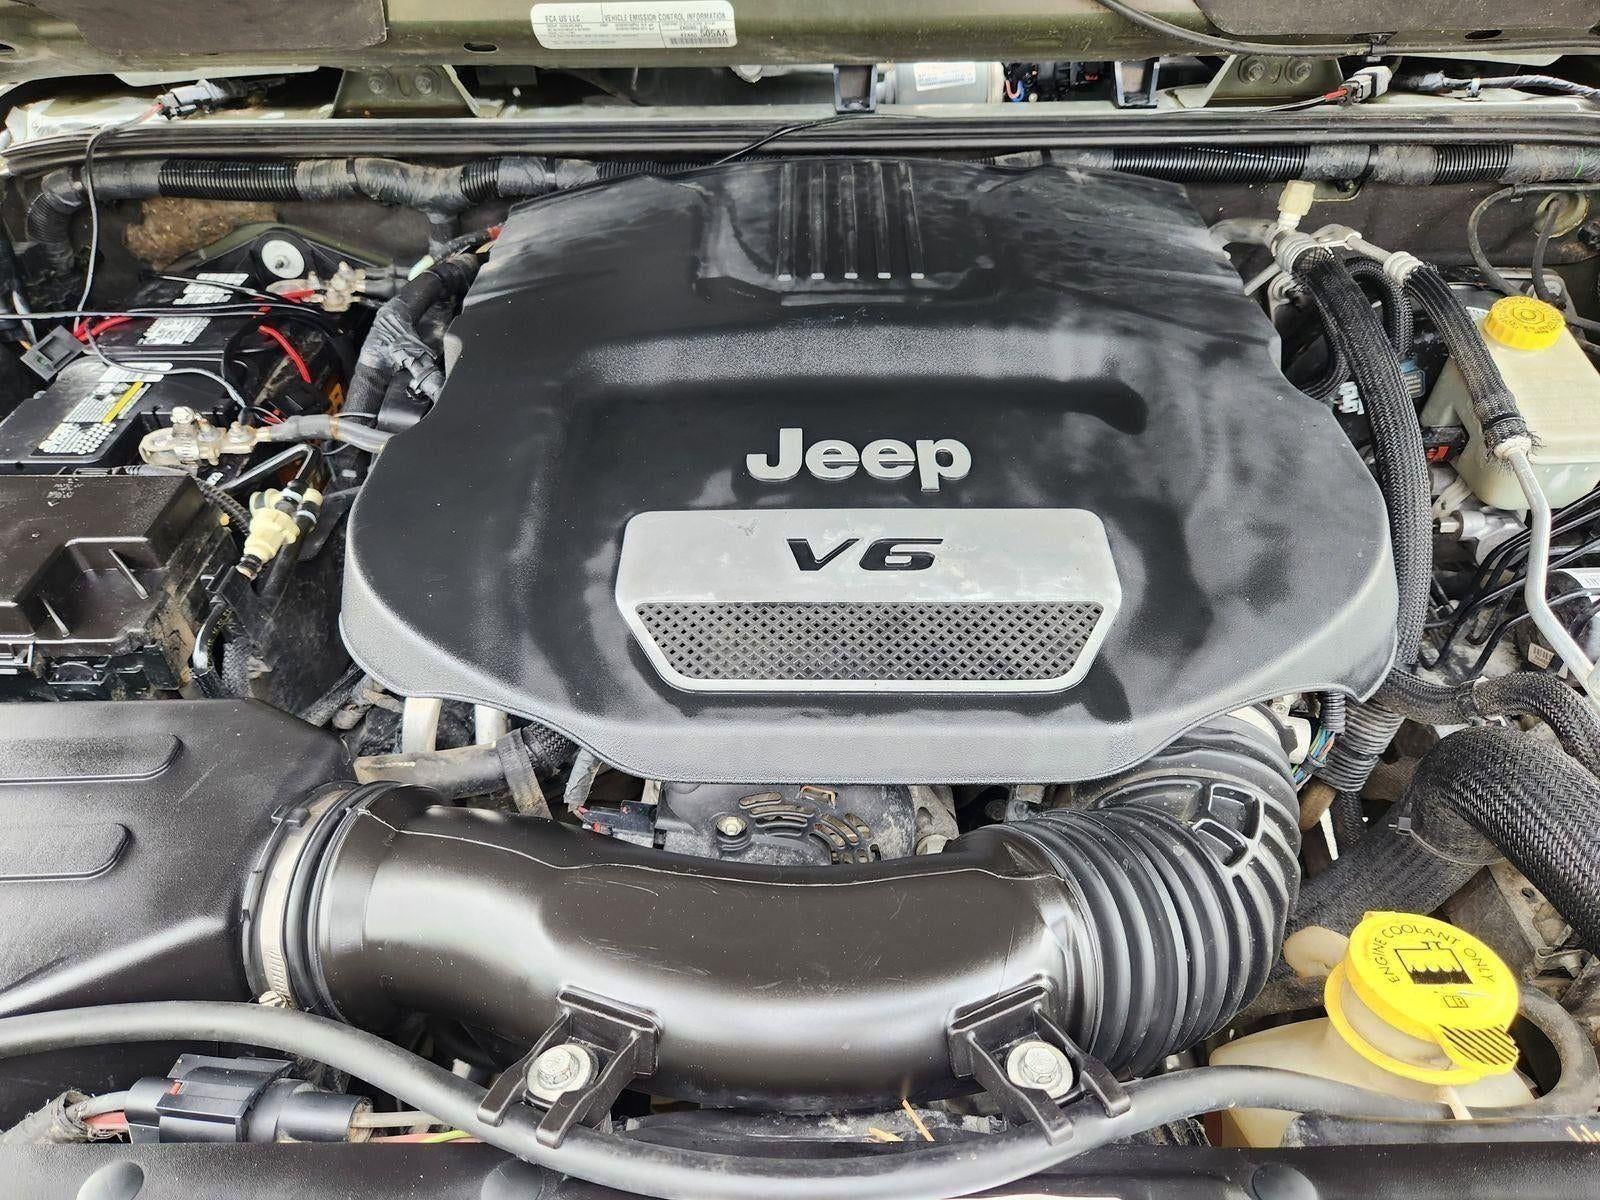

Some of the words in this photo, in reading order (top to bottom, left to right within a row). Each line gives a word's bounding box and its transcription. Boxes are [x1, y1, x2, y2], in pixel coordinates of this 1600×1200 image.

[604, 14, 627, 22] VEHICLE
[658, 13, 686, 21] CONTROL
[687, 12, 726, 20] INFORMATION
[746, 427, 972, 492] Jeep
[785, 538, 944, 571] V6
[1381, 923, 1461, 946] COOLANT
[1372, 936, 1401, 984] ENGINE
[1463, 947, 1496, 984] ONLY
